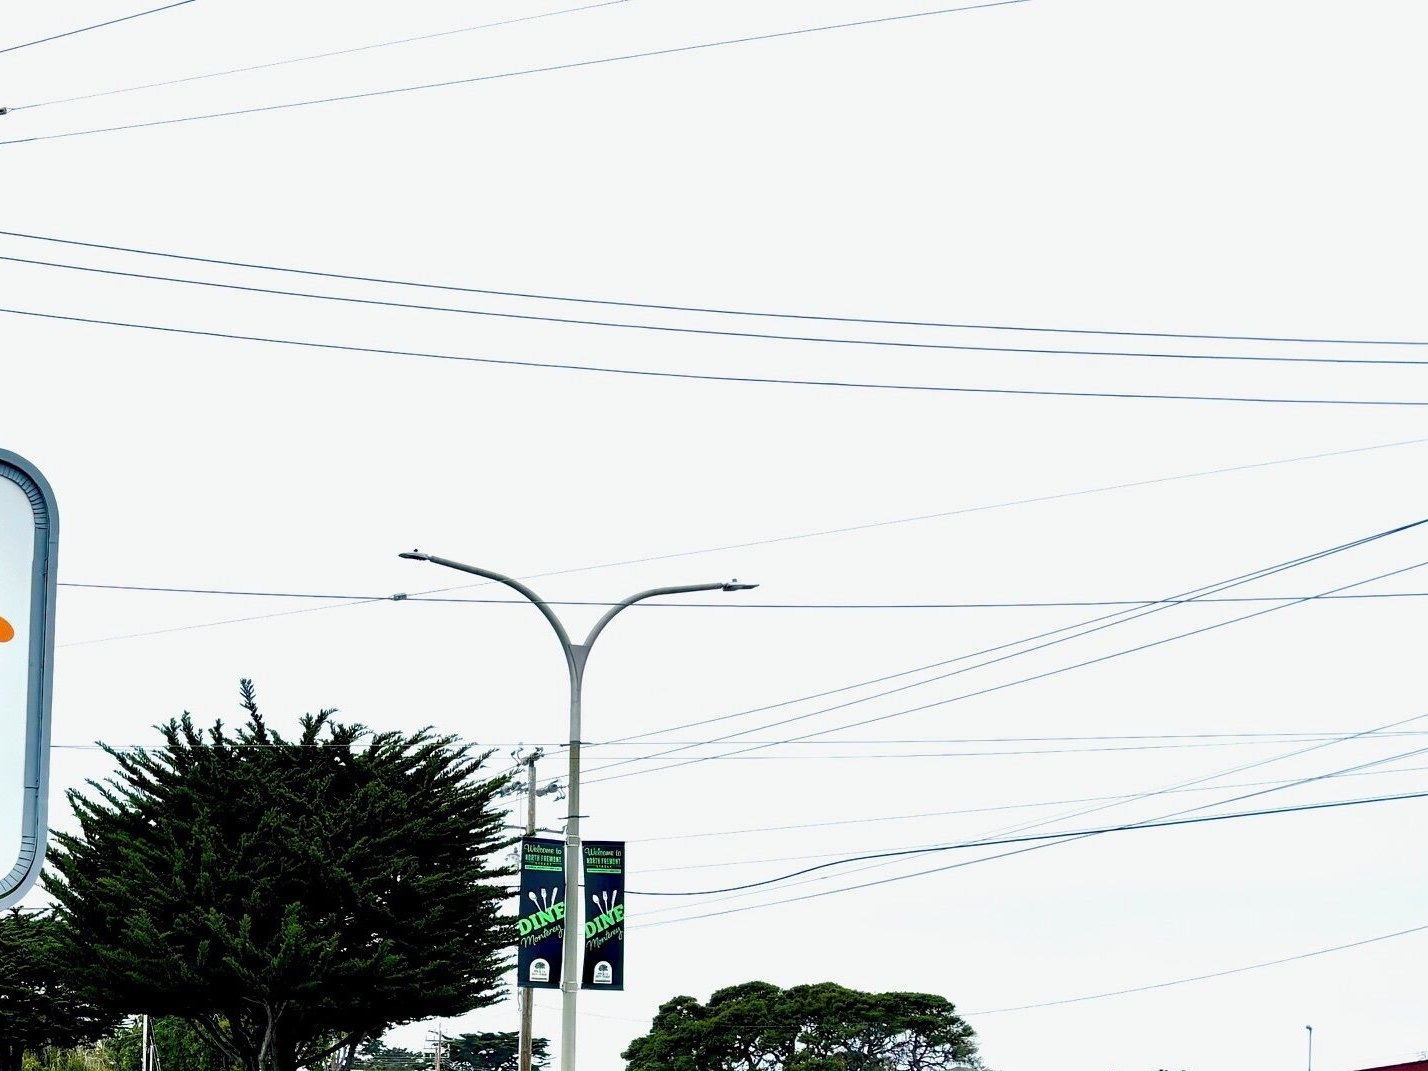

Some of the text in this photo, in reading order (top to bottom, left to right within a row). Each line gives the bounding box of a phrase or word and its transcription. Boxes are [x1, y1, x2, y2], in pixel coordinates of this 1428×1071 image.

[524, 844, 554, 854] Welcome
[584, 848, 614, 857] Welcome
[518, 901, 565, 936] DINE
[585, 903, 624, 939] DINE
[521, 924, 564, 948] Monterey
[586, 926, 624, 951] Monterey
